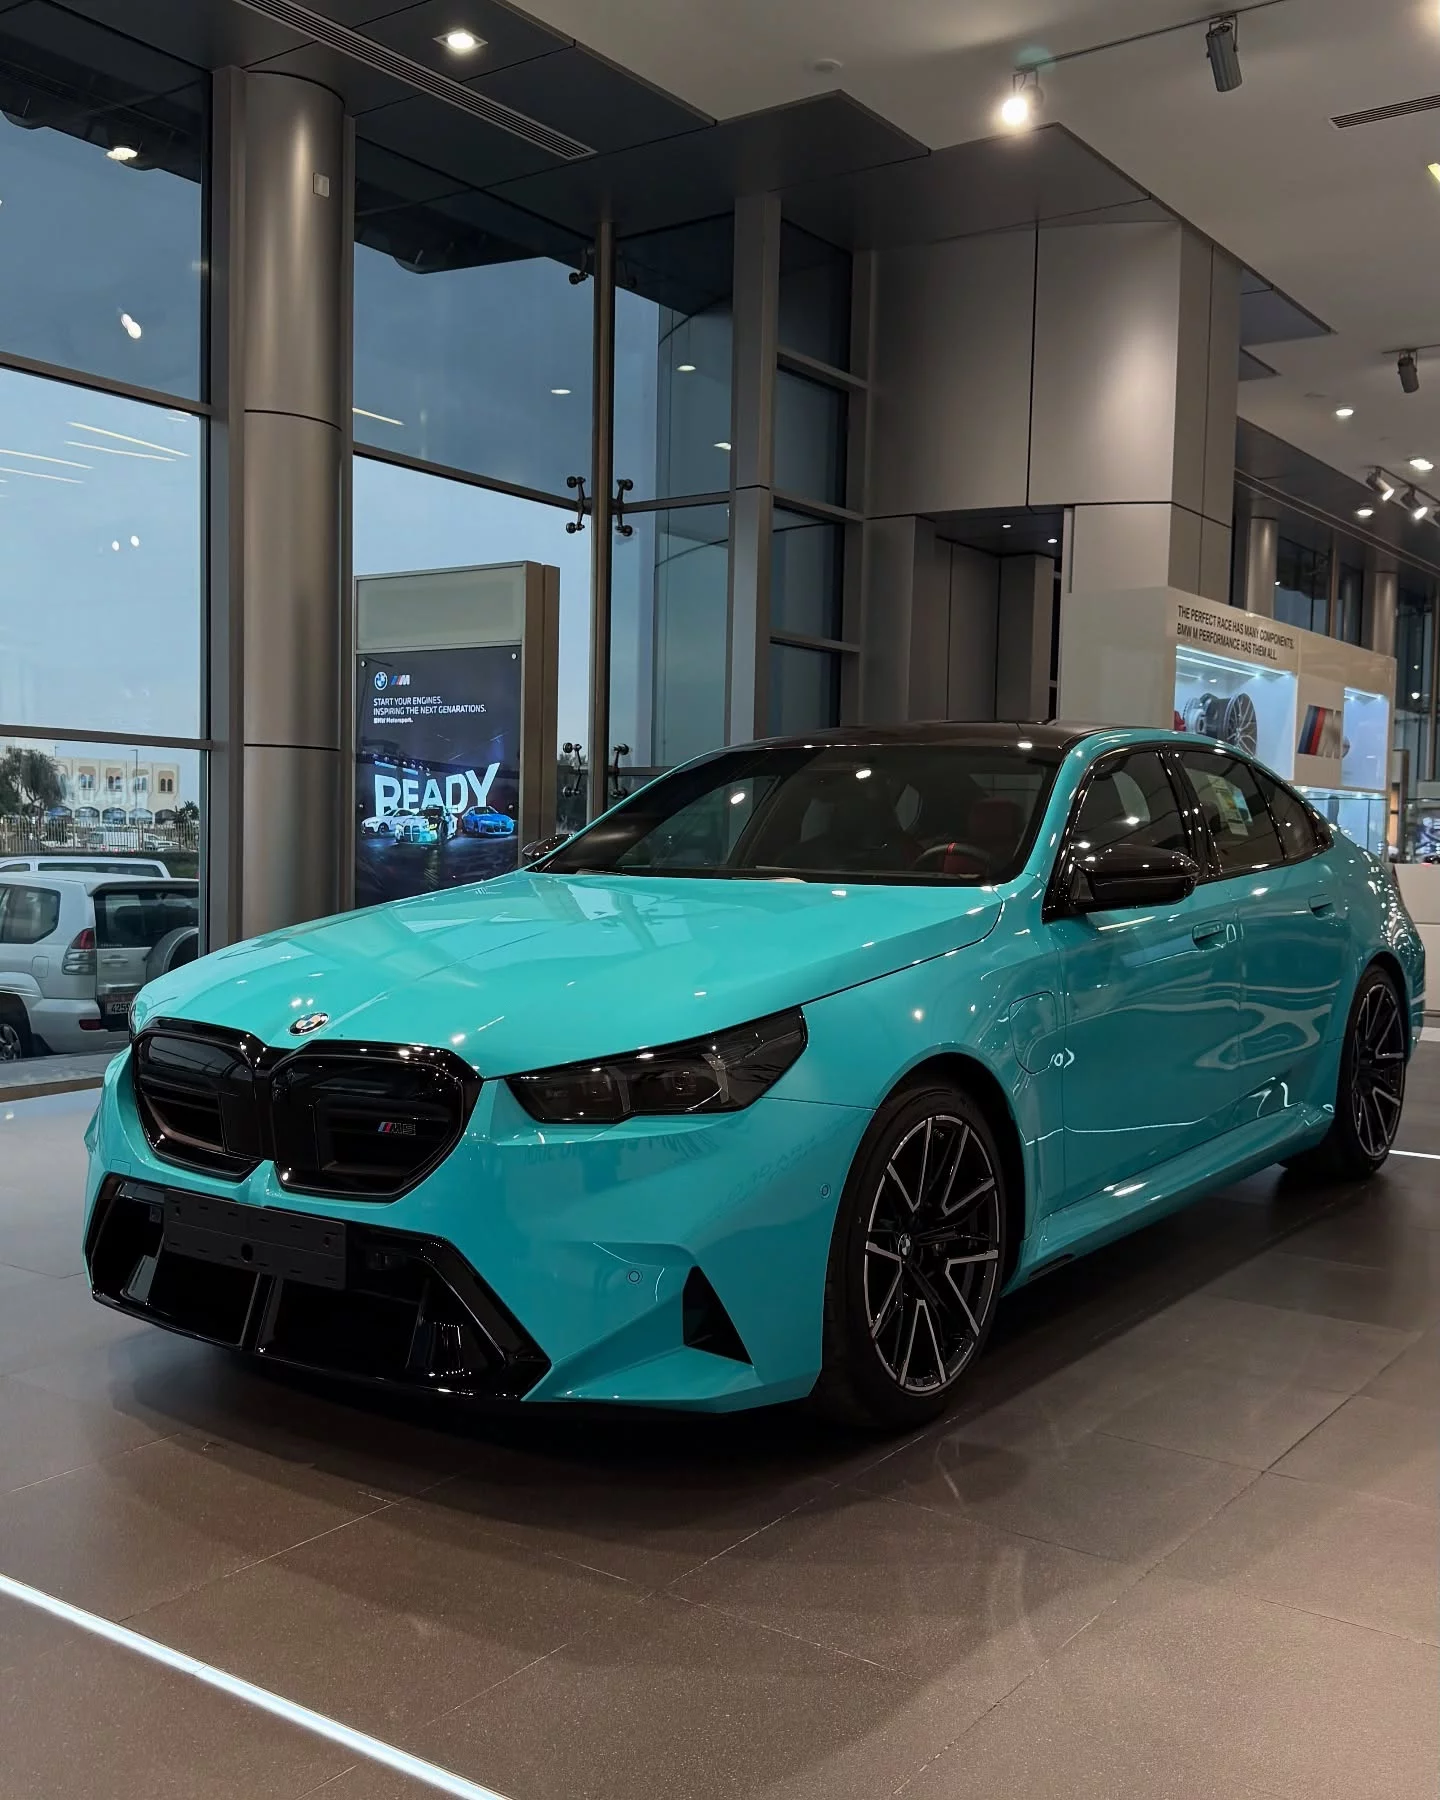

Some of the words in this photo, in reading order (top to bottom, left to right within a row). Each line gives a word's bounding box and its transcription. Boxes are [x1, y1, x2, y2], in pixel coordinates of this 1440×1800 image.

[1178, 605, 1190, 619] THE
[1191, 608, 1216, 627] PERFECT
[1217, 616, 1232, 631] RACE
[1233, 621, 1244, 635] HAS
[1177, 622, 1192, 637] BMW
[1192, 627, 1198, 639] M
[1199, 628, 1240, 650] PERFORMANCE
[1241, 640, 1251, 654] HAS
[1252, 643, 1266, 656] THEM
[373, 697, 394, 706] START
[394, 697, 412, 706] YOUR
[412, 696, 443, 705] ENGINES.
[373, 706, 405, 716] INSPIRING
[405, 706, 419, 715] THE
[420, 705, 438, 714] NEXT
[375, 762, 501, 819] READY
